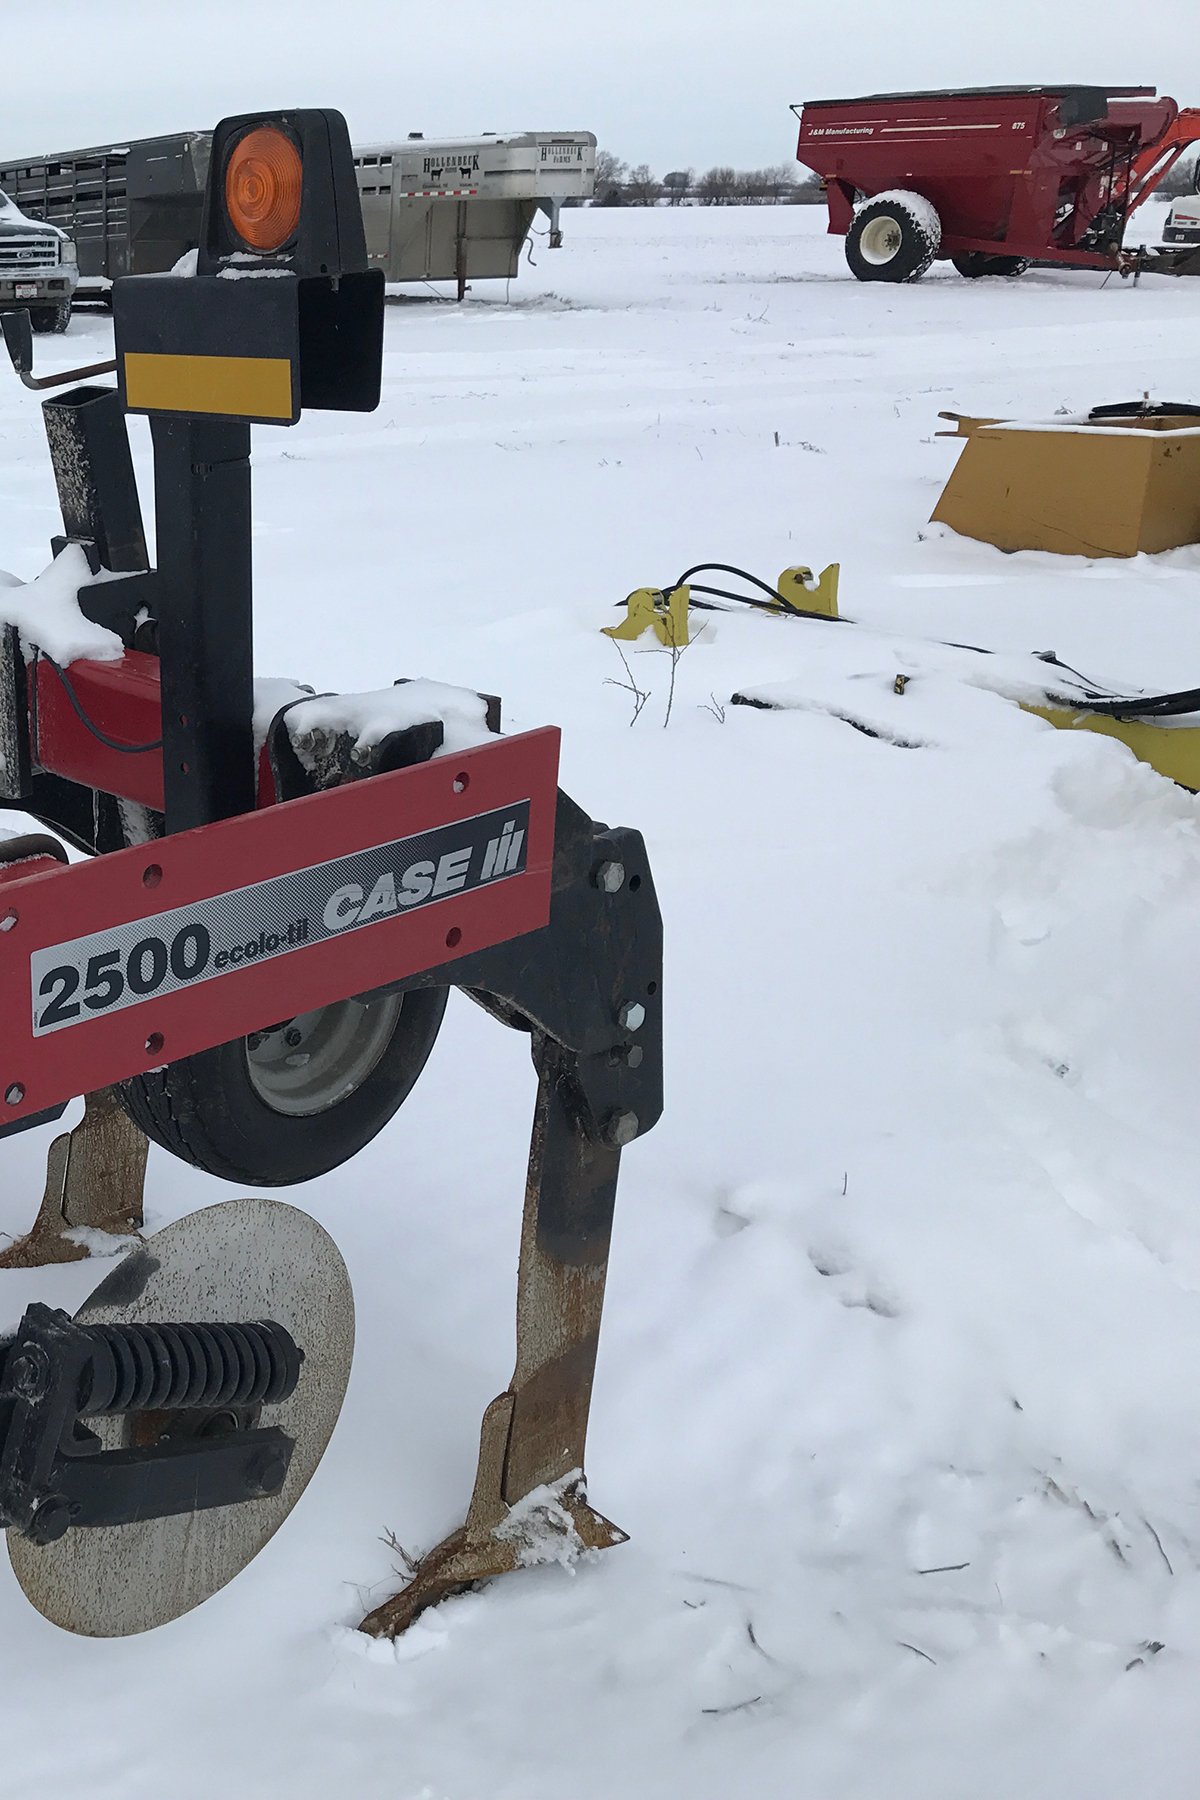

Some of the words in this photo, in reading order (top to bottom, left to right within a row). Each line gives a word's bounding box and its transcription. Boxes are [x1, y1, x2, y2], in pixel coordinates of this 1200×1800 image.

[808, 128, 825, 137] J&M
[825, 127, 874, 136] Manufacturing
[1012, 122, 1025, 130] 875
[423, 154, 480, 173] HOLLENBECK
[37, 924, 211, 1029] 2500
[215, 919, 310, 969] ecolo-til
[323, 846, 474, 931] CASE
